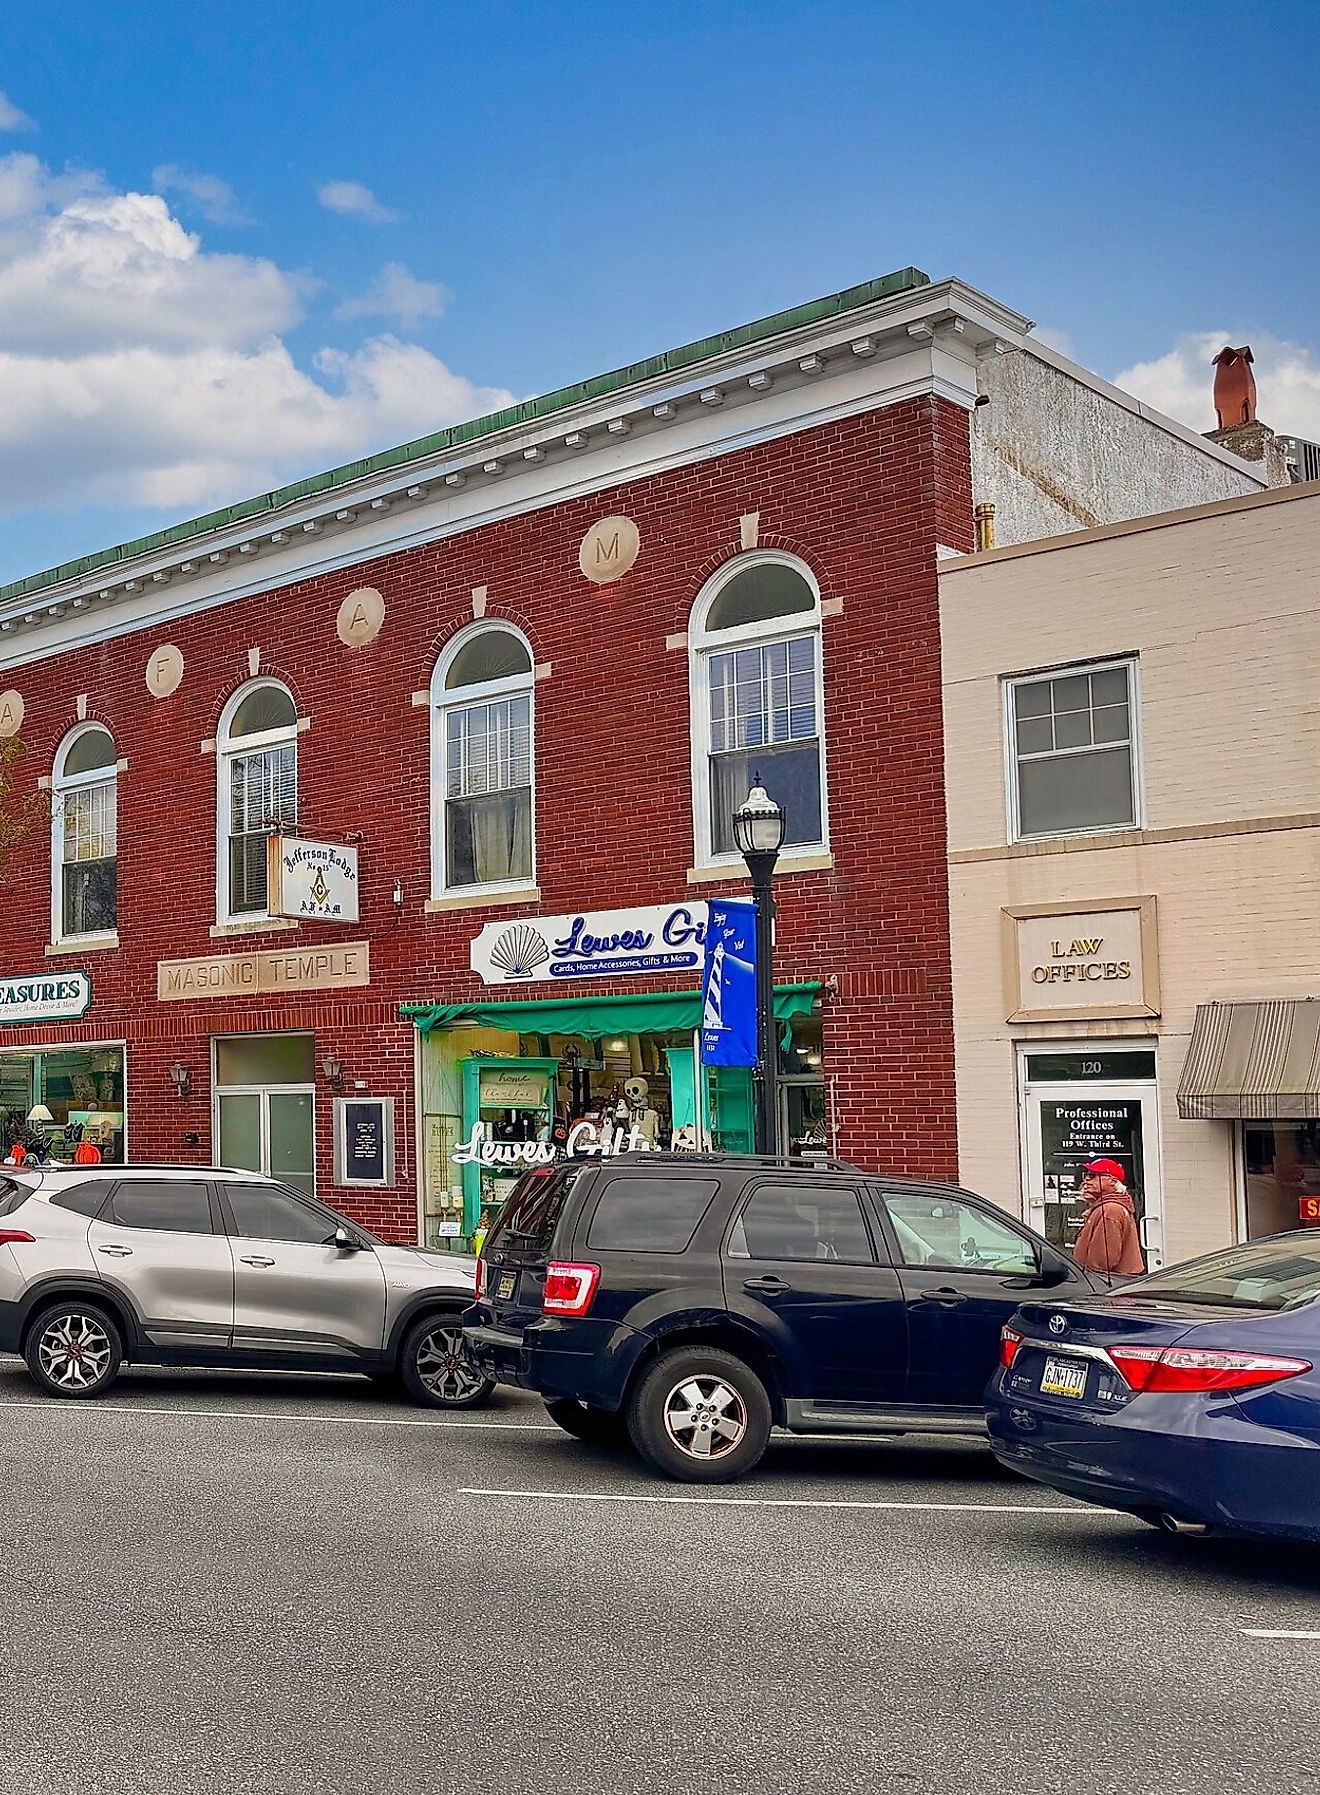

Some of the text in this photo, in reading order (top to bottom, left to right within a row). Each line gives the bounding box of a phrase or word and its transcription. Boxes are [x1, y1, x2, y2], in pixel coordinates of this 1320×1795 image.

[0, 532, 619, 724] A F A M
[283, 847, 356, 881] Jefferson Lodge
[551, 916, 655, 958] Lewes
[1051, 938, 1104, 958] LAW
[167, 952, 358, 991] MASONIC TEMPLE
[553, 954, 690, 973] Cards, Home Accessories, Gifts & More
[1031, 961, 1131, 984] OFFICES
[1081, 1061, 1102, 1074] 120
[1055, 1107, 1129, 1119] Professional
[1070, 1119, 1114, 1130] Offices
[450, 1121, 555, 1167] Lewes
[1062, 1140, 1125, 1148] 119 W. Third St.
[1069, 1132, 1104, 1140] Entrance
